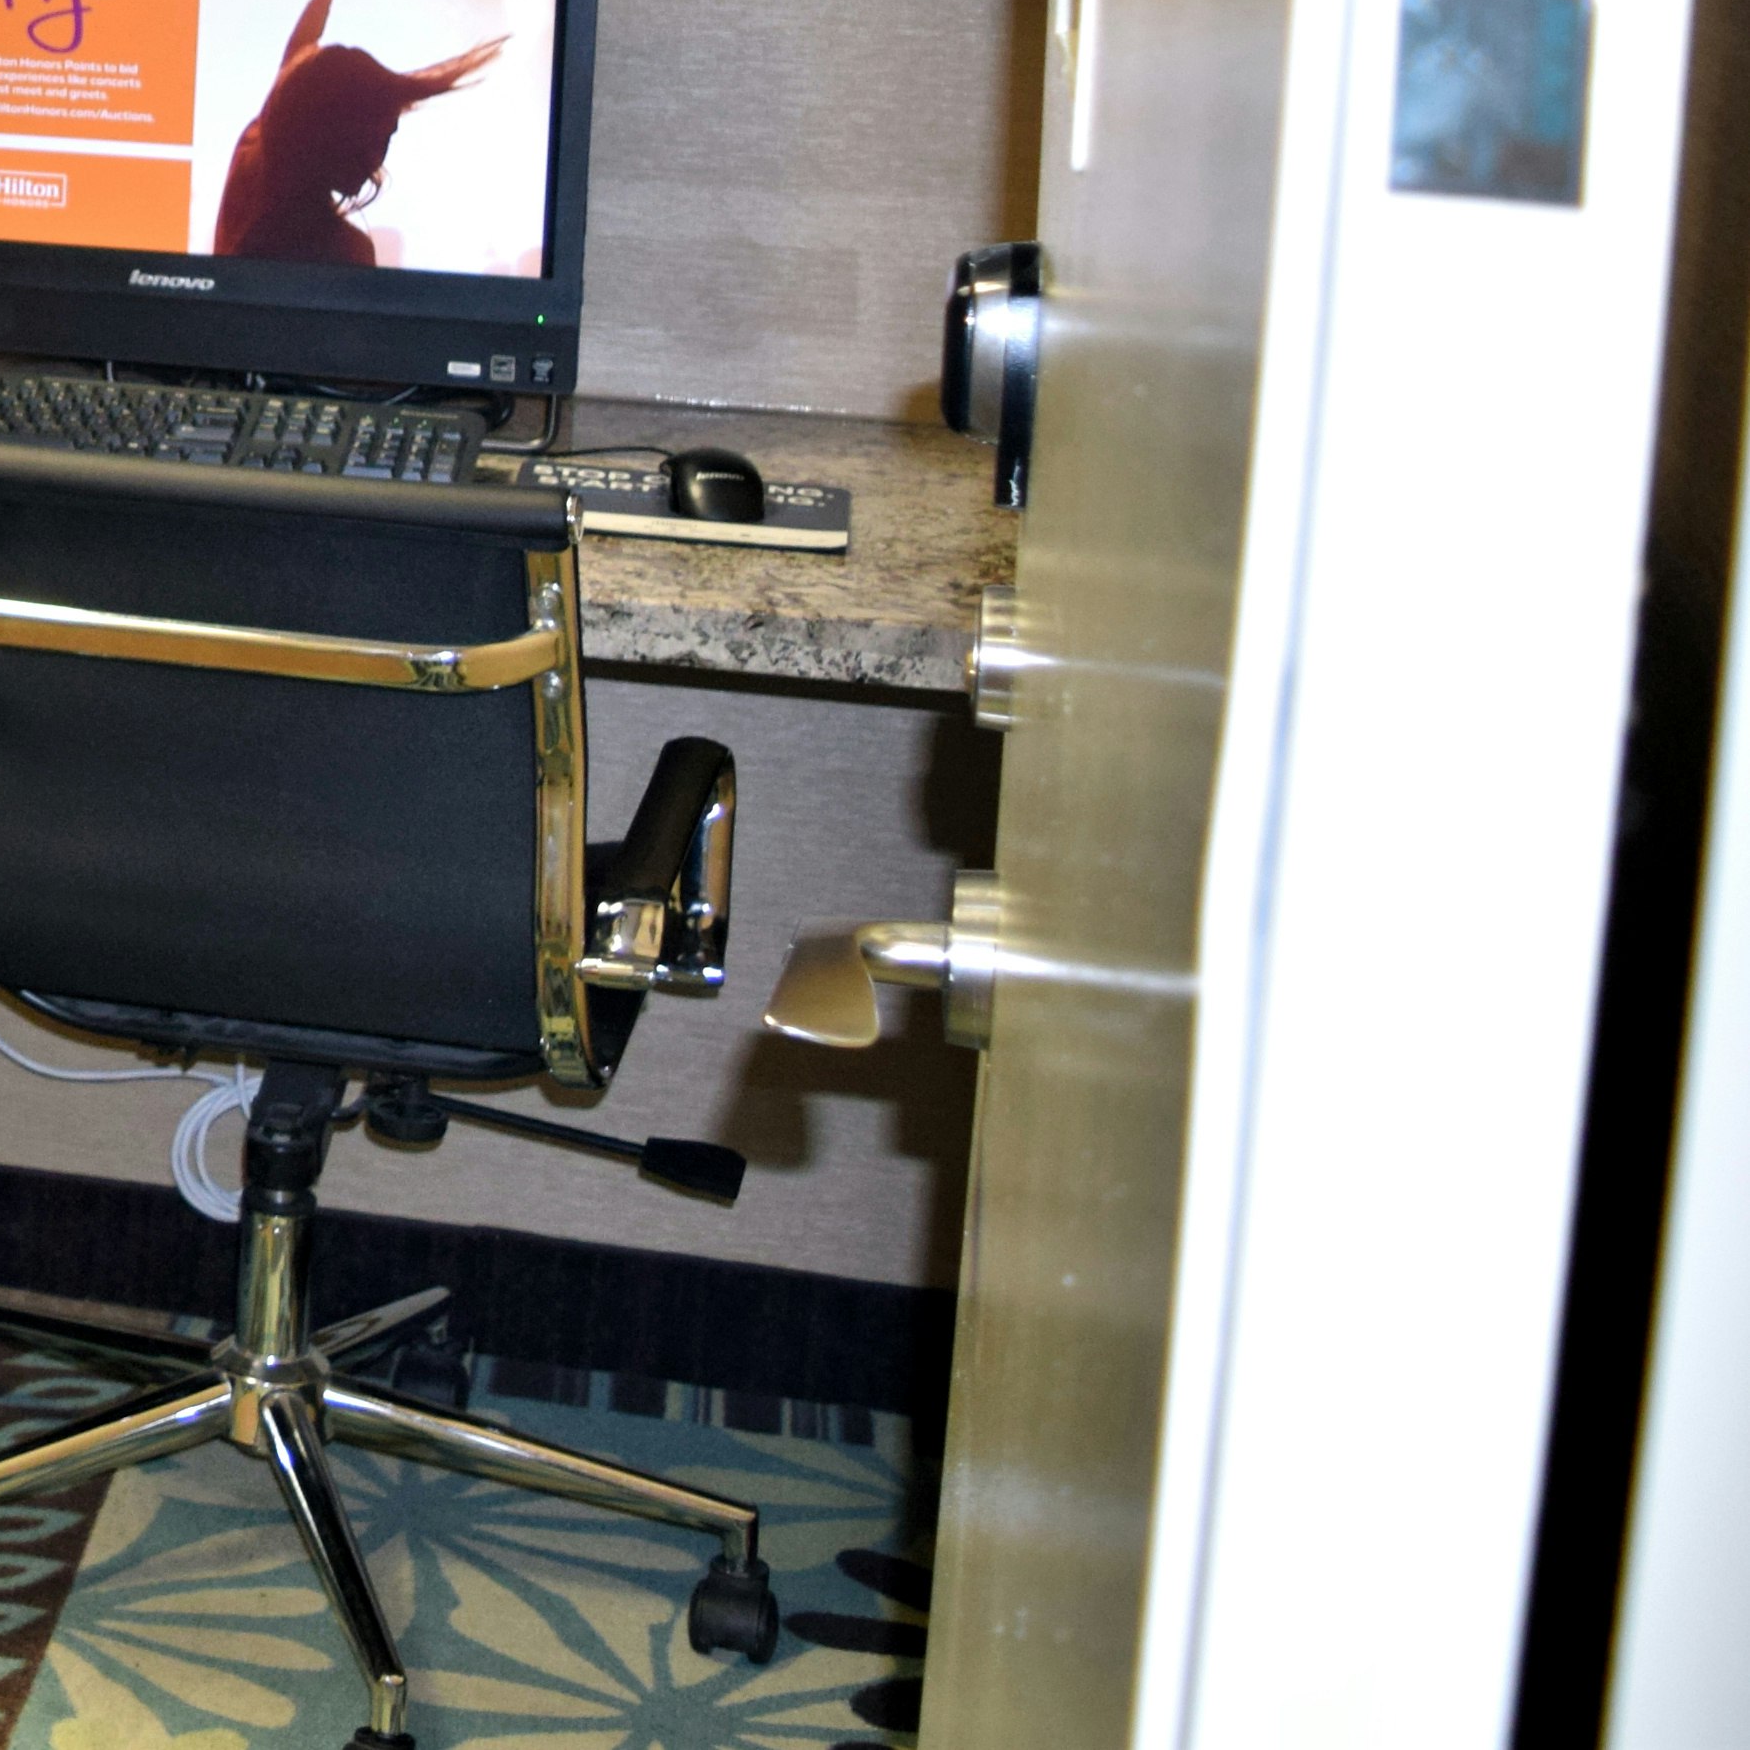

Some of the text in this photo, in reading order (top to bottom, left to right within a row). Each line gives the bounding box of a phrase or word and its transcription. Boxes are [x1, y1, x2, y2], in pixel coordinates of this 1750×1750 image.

[19, 57, 62, 70] Honors
[64, 60, 101, 72] Points
[104, 63, 117, 73] to
[119, 63, 139, 75] bid
[67, 73, 87, 85] like
[90, 75, 141, 88] concerts
[12, 84, 42, 96] meet
[45, 86, 67, 98] and
[69, 89, 109, 101] greets.
[129, 268, 215, 292] lenovo
[533, 463, 631, 481] STOP
